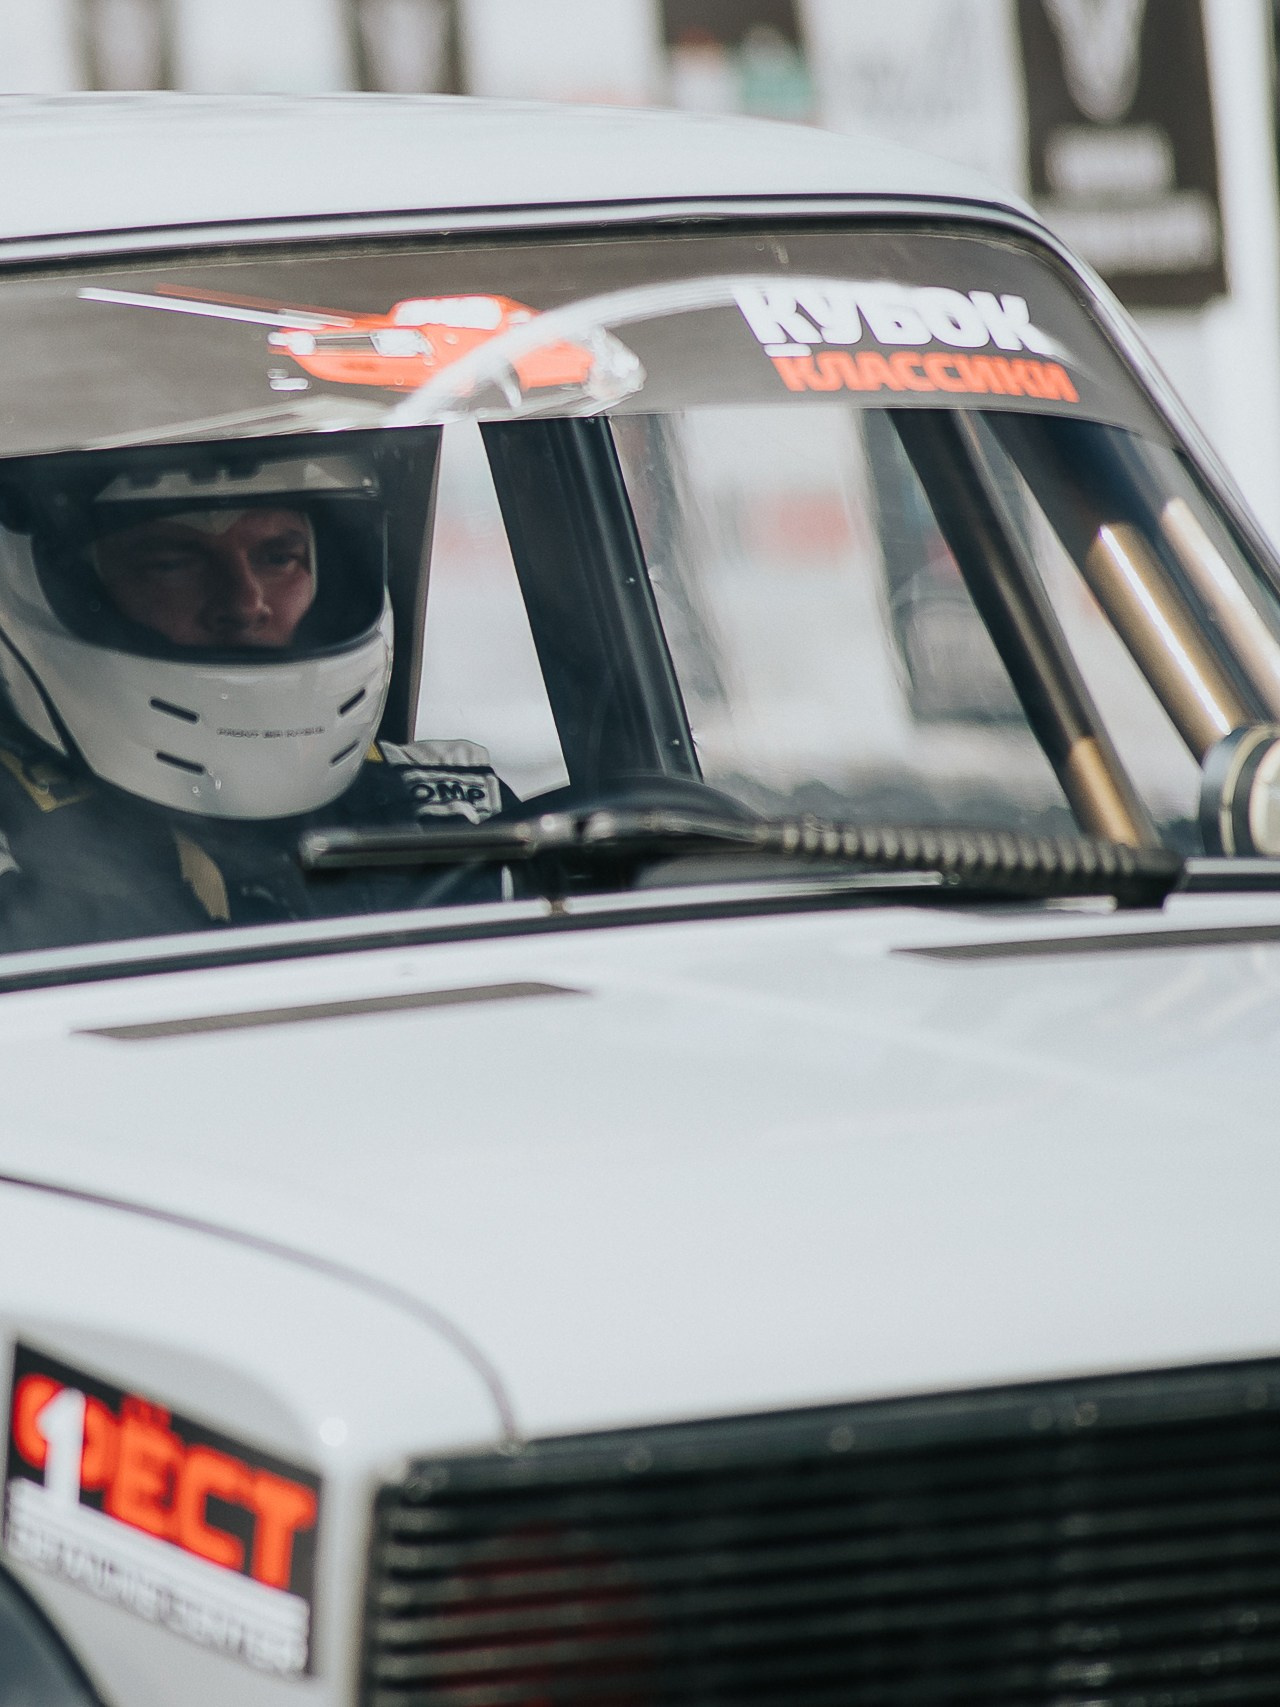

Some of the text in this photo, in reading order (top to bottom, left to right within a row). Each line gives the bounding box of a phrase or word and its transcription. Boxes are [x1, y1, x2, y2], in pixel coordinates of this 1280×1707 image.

[734, 284, 1055, 354] КУБОК
[772, 350, 1081, 403] КЛАССИКИ
[411, 781, 486, 806] OMP
